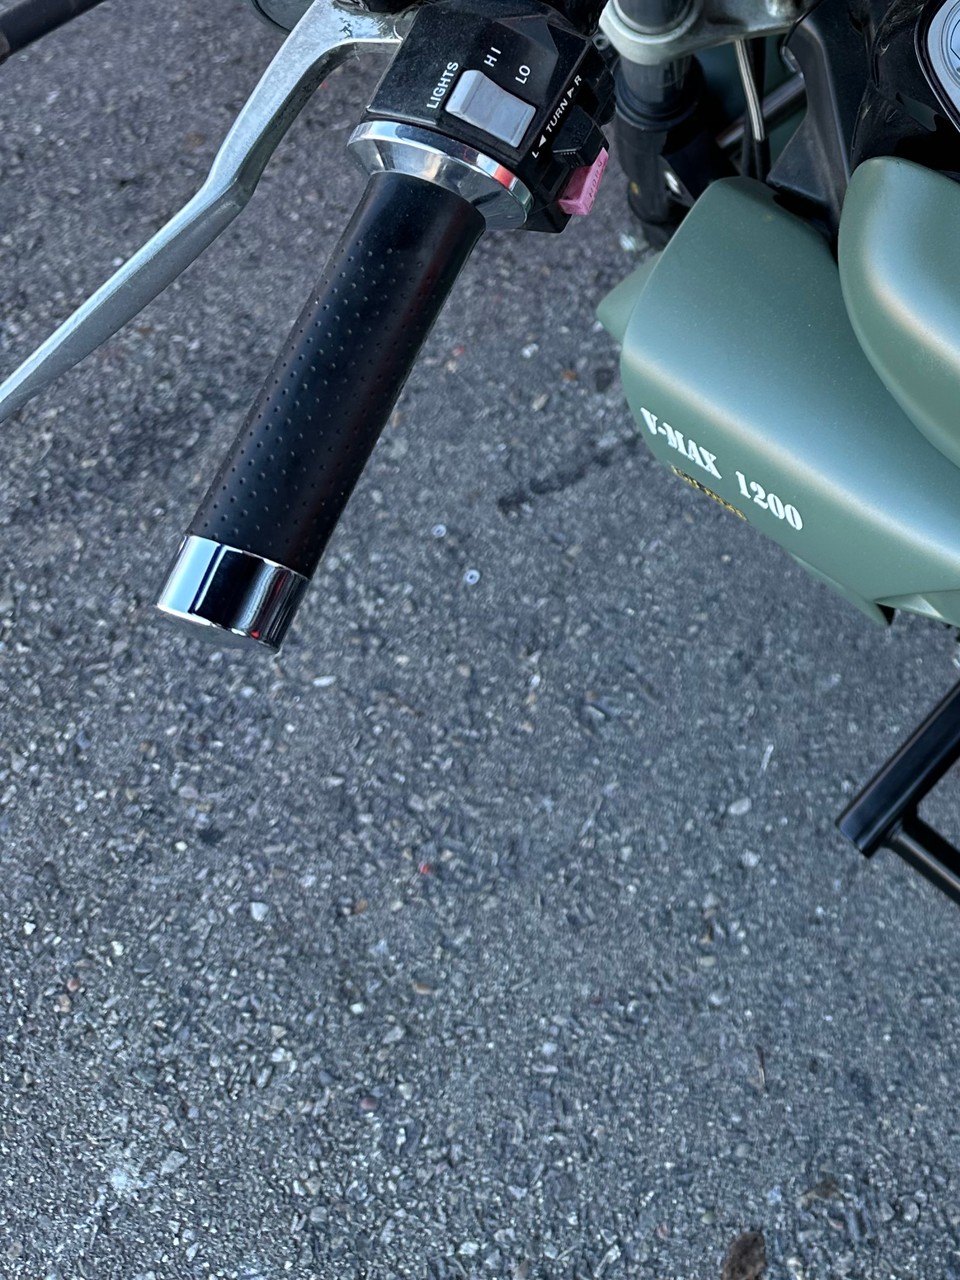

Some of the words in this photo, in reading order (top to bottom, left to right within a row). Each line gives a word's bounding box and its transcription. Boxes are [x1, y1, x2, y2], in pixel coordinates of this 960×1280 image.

[483, 46, 502, 68] HI
[515, 64, 531, 85] LO
[426, 60, 459, 110] LIGHTS
[531, 149, 539, 159] L
[546, 98, 568, 134] TURN
[574, 74, 583, 87] R
[640, 406, 723, 480] V-MAX
[735, 470, 804, 531] 1200
